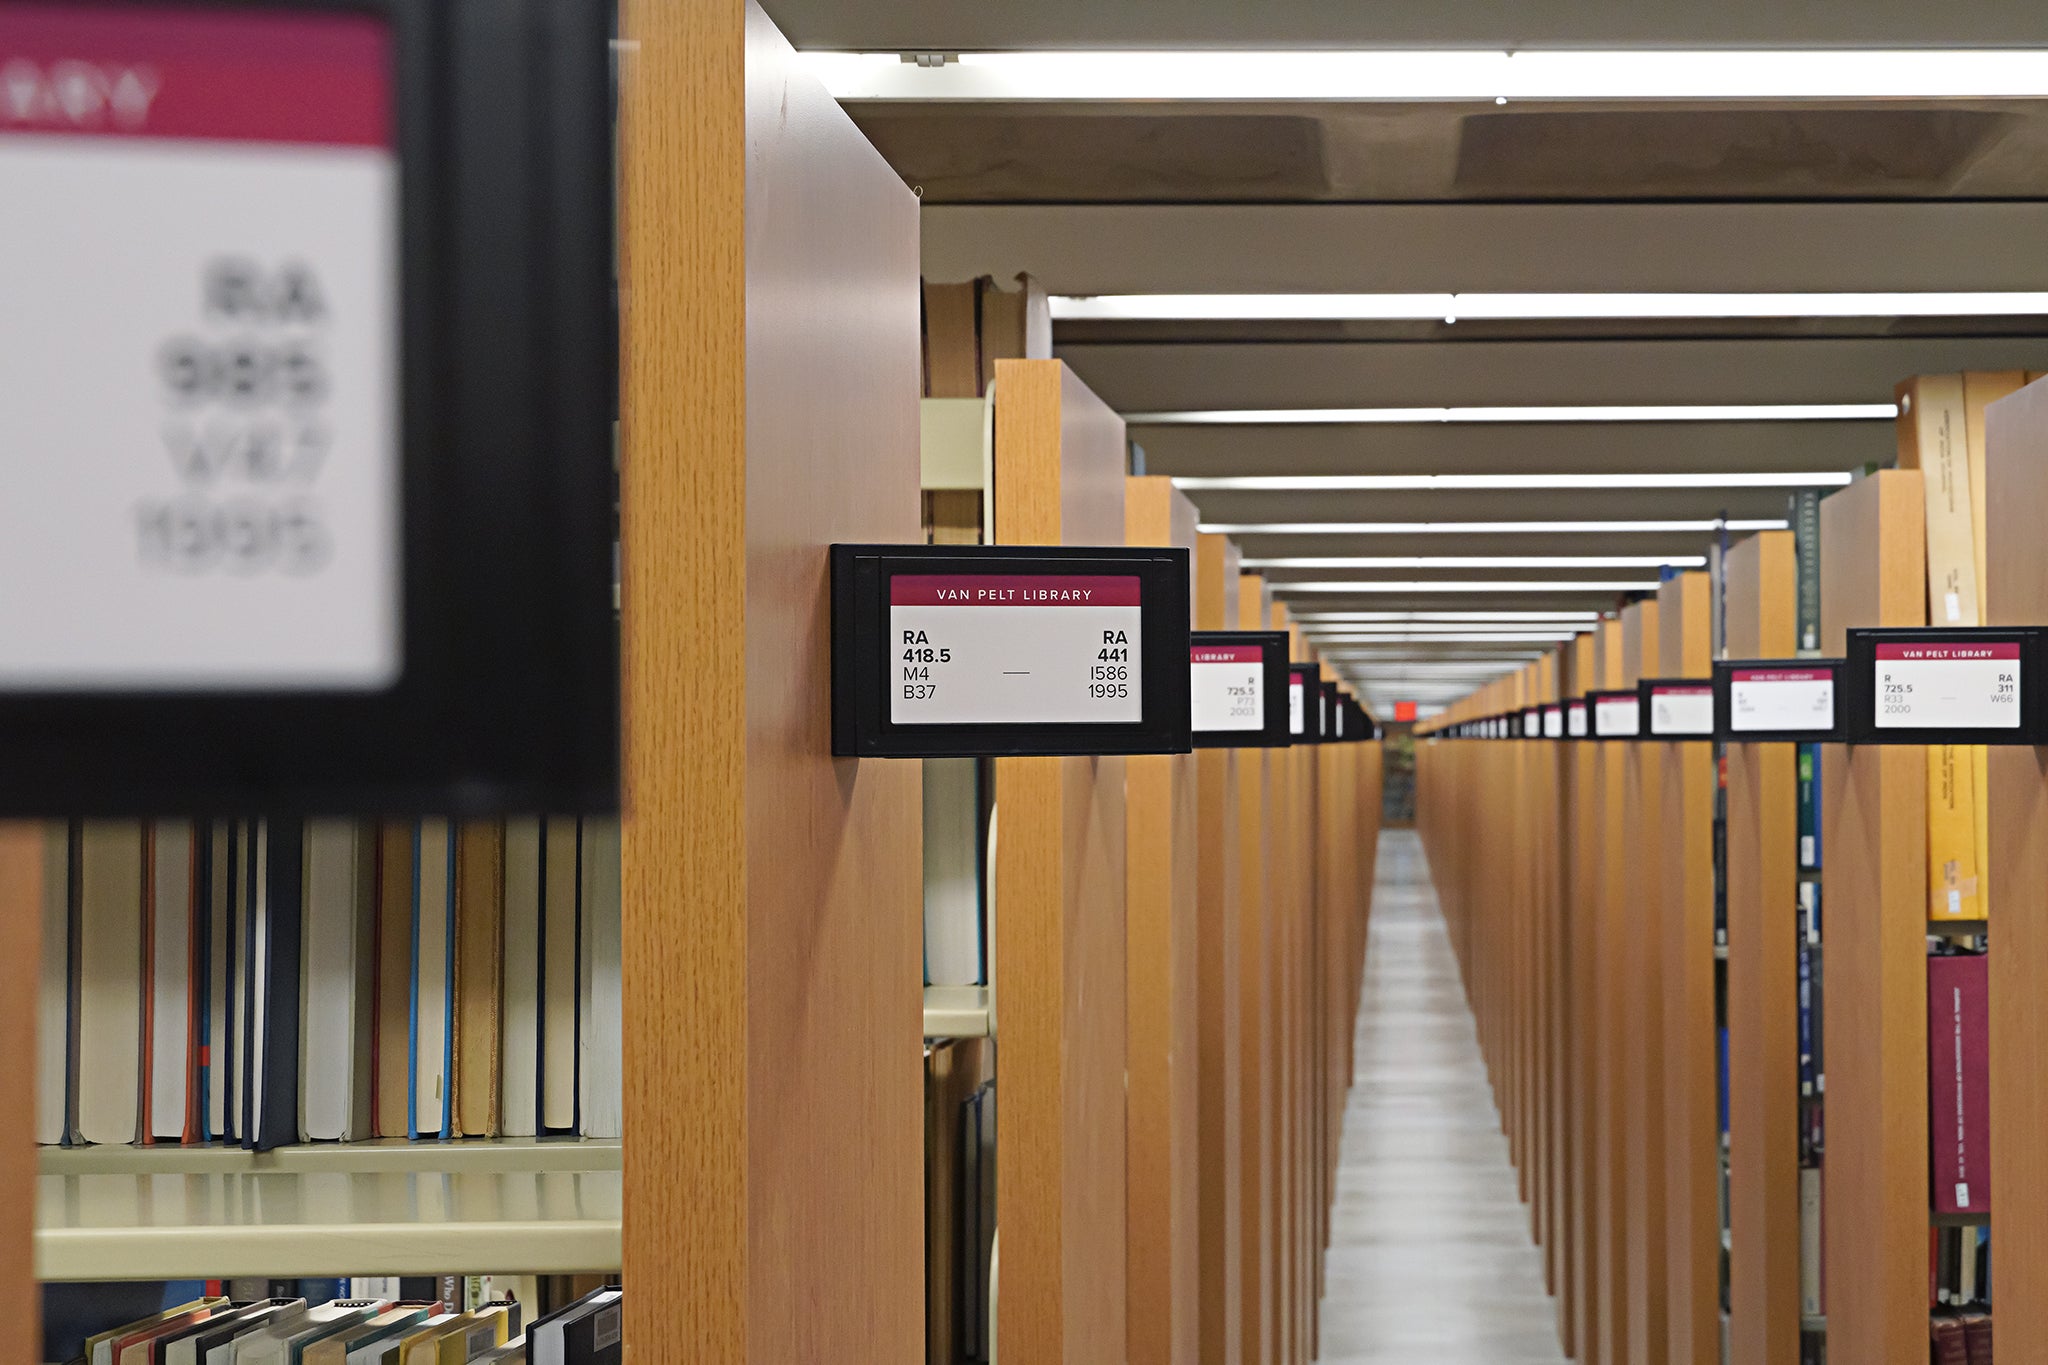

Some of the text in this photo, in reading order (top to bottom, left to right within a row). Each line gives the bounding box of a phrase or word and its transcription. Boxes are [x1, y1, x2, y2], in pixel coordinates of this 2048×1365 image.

[203, 256, 327, 320] RA
[936, 589, 1092, 601] VAN PELT LIBRARY
[903, 630, 929, 645] RA
[1103, 630, 1128, 645] RA
[902, 648, 951, 663] 418.5
[1097, 648, 1128, 663] 441
[1195, 653, 1235, 661] LIBRARY
[1902, 649, 1993, 658] VAN PELT LIBRARY
[903, 666, 930, 681] M4
[1884, 674, 1892, 683] R
[1998, 673, 2014, 683] RA
[1247, 676, 1255, 685] R
[903, 684, 937, 700] B37
[1088, 683, 1128, 699] 1995
[1227, 687, 1255, 696] 725.5
[1884, 684, 1913, 693] 725.5
[1998, 683, 2014, 693] 311
[1990, 694, 2014, 703] W66
[1884, 704, 1912, 714] 2000
